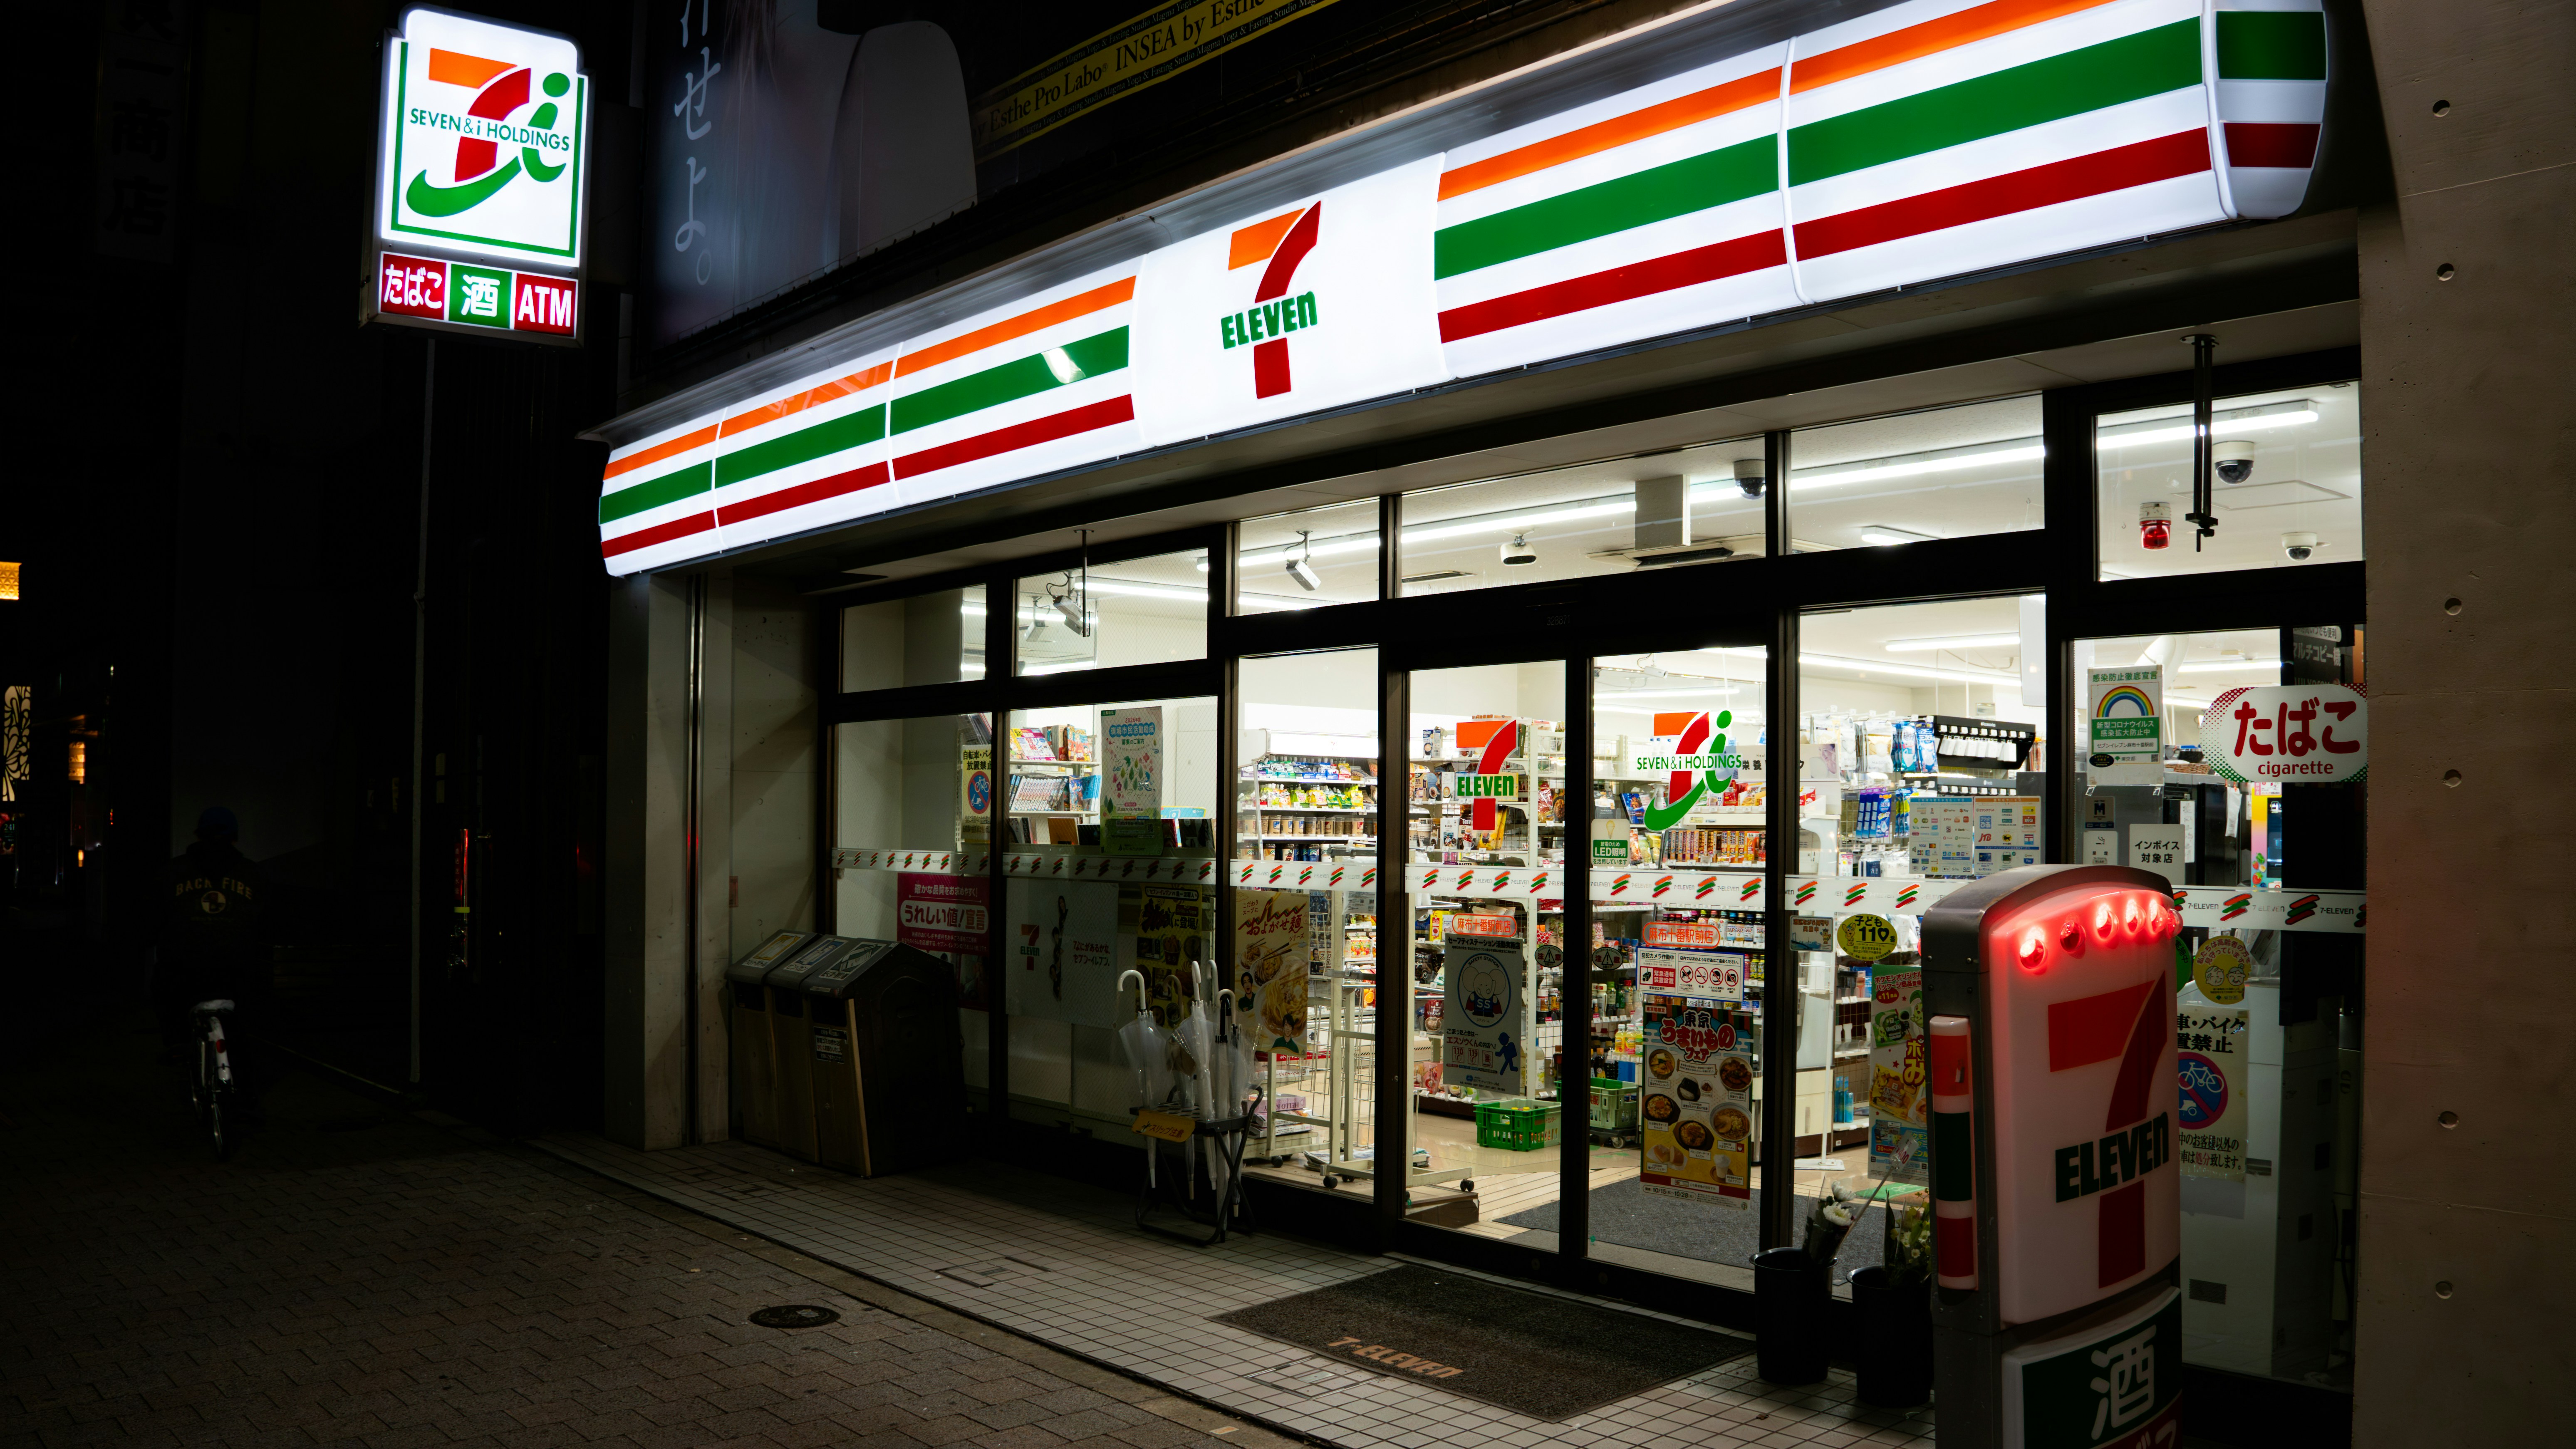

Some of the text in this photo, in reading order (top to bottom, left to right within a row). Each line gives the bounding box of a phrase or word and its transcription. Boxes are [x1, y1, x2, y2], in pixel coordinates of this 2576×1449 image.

[1131, 18, 1150, 33] Studio
[1152, 7, 1174, 23] Magma
[1104, 82, 1125, 97] Magma
[1127, 76, 1141, 87] Yoga
[1151, 62, 1173, 77] Fasting
[1174, 52, 1195, 67] Studio
[1197, 39, 1220, 57] Magma
[1222, 31, 1238, 44] Yoga
[1239, 26, 1246, 36] &
[1249, 15, 1273, 32] Fasting
[1274, 2, 1297, 20] Studio
[990, 97, 1031, 132] Esthe
[1034, 85, 1060, 111] Pro
[1115, 24, 1177, 72] INSEA
[1183, 15, 1206, 45] by
[487, 123, 570, 152] HOLDINGS
[383, 263, 443, 310] たばこ
[461, 274, 500, 318] 酒
[1228, 201, 1321, 399] 7
[518, 284, 572, 328] ATM
[2092, 671, 2157, 683] 感染防止徹底宣言
[2096, 720, 2155, 729] 新型コロナウイルス
[2100, 728, 2150, 737] 感染拡大防止中
[2234, 696, 2360, 757] たばこ
[1686, 754, 1741, 769] HOLDINGS
[2258, 761, 2333, 778] cigarette
[1456, 720, 1516, 830] 7
[1595, 847, 1626, 857] LED照明
[2135, 840, 2180, 851] インボイス
[2141, 852, 2173, 864] 対象店
[1243, 899, 1258, 908] こだわり
[1243, 907, 1258, 916] スープに
[1246, 915, 1304, 936] およがせ麺
[1457, 918, 1511, 934] 麻布十番駅前店
[1855, 916, 1882, 927] 子ども
[1289, 932, 1305, 941] シリーズ
[1448, 936, 1521, 949] セーフティステーション活動実施店
[1649, 928, 1714, 944] 麻布十番駅前店
[1468, 956, 1500, 968] SAFETY STATION
[1476, 999, 1491, 1009] SS
[1684, 1010, 1711, 1029] 東京
[1661, 1019, 1736, 1050] うまいもの
[1469, 1049, 1478, 1058] 119
[1685, 1048, 1709, 1062] フェア
[1149, 1124, 1185, 1138] スリップ注意
[2048, 970, 2167, 1289] 7
[2090, 1323, 2157, 1441] 酒
